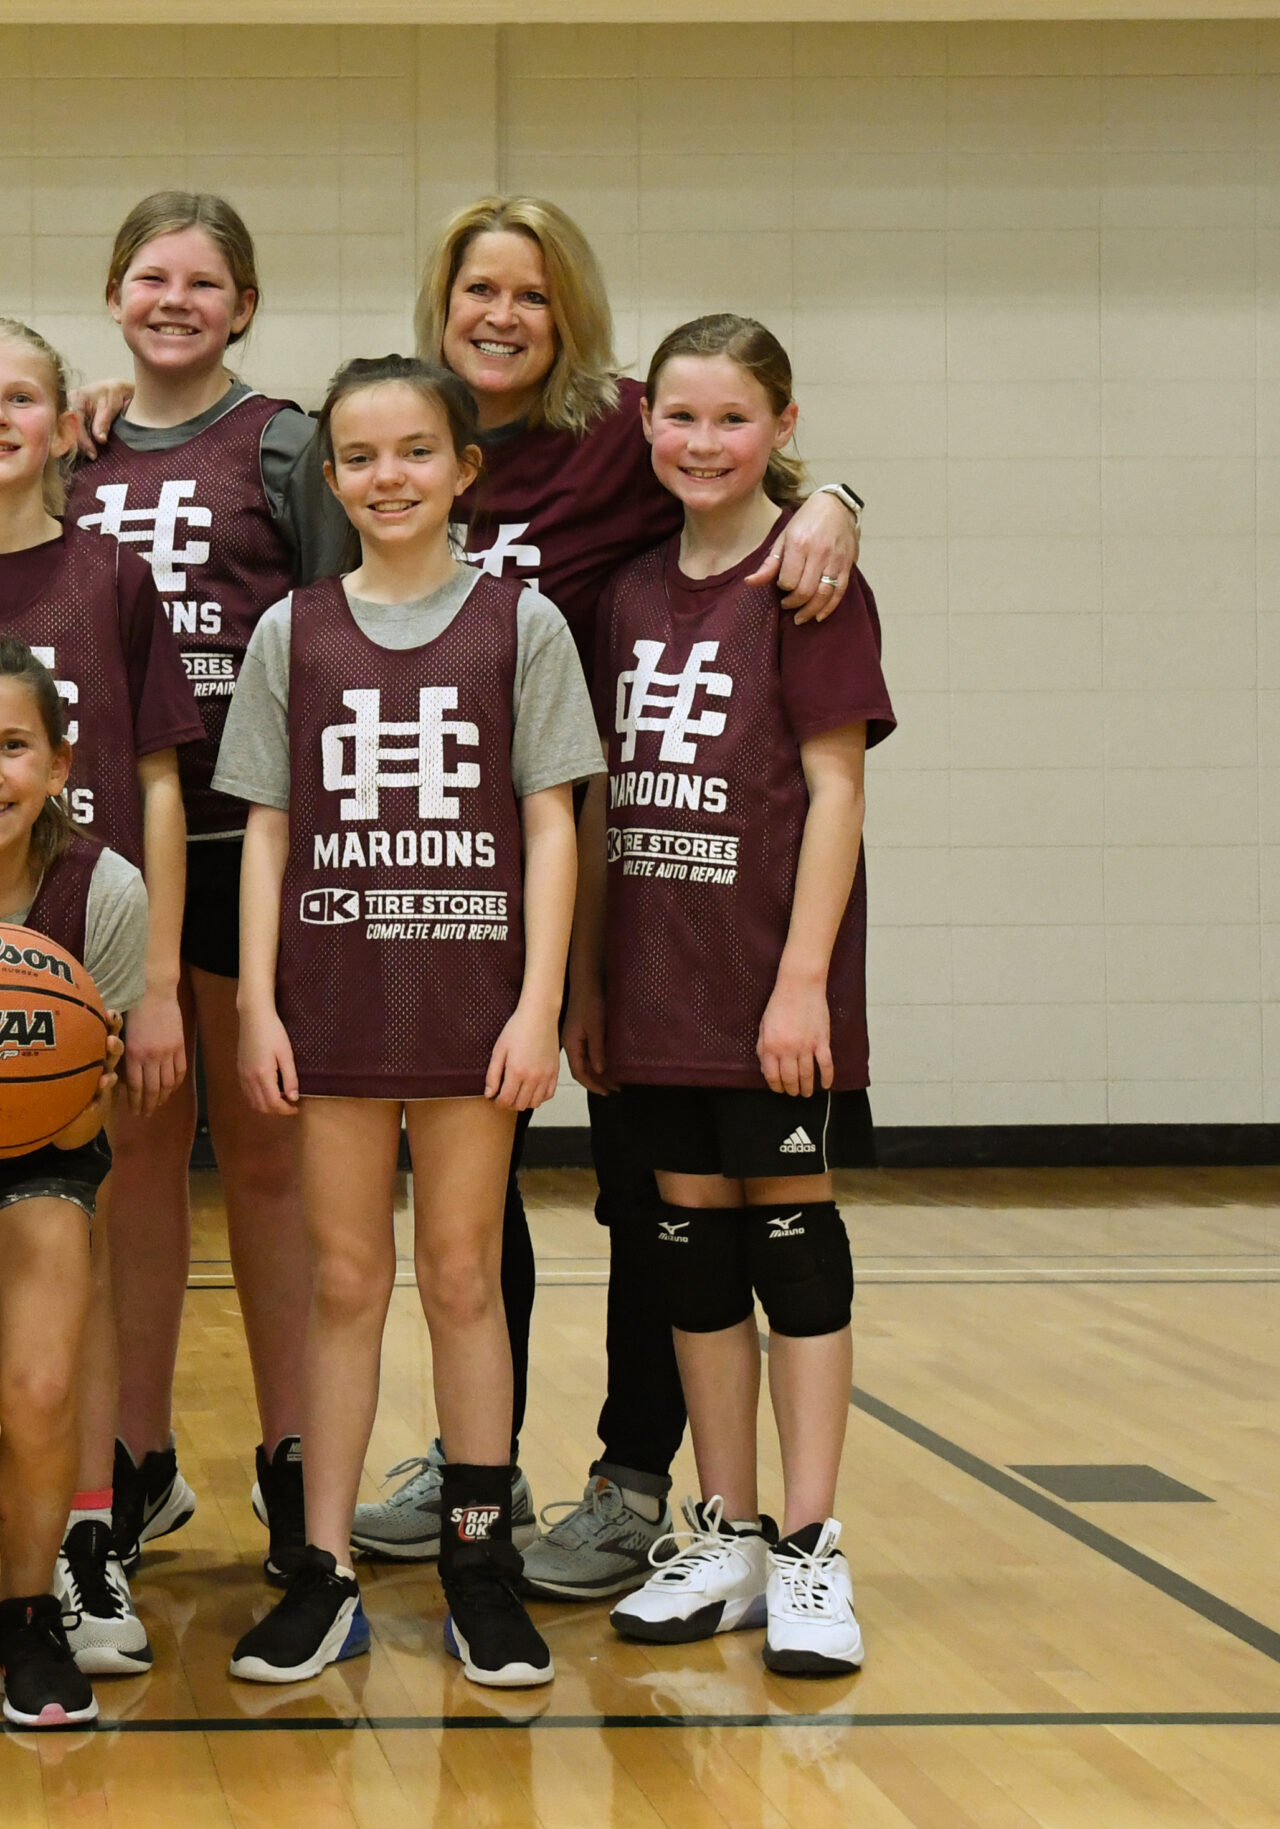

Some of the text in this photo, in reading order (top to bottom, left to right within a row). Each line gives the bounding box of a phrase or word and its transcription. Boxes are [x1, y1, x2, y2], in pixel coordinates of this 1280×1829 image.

[610, 771, 728, 813] MAROONS
[313, 830, 496, 870] MAROONS
[648, 836, 738, 860] STORES
[655, 863, 688, 882] AUTO
[689, 866, 737, 885] REPAIR
[365, 896, 415, 914] TIRE
[422, 896, 508, 915] STORES
[366, 923, 508, 941] COMPLETE AUTO REPAIR
[779, 1143, 816, 1153] adidas
